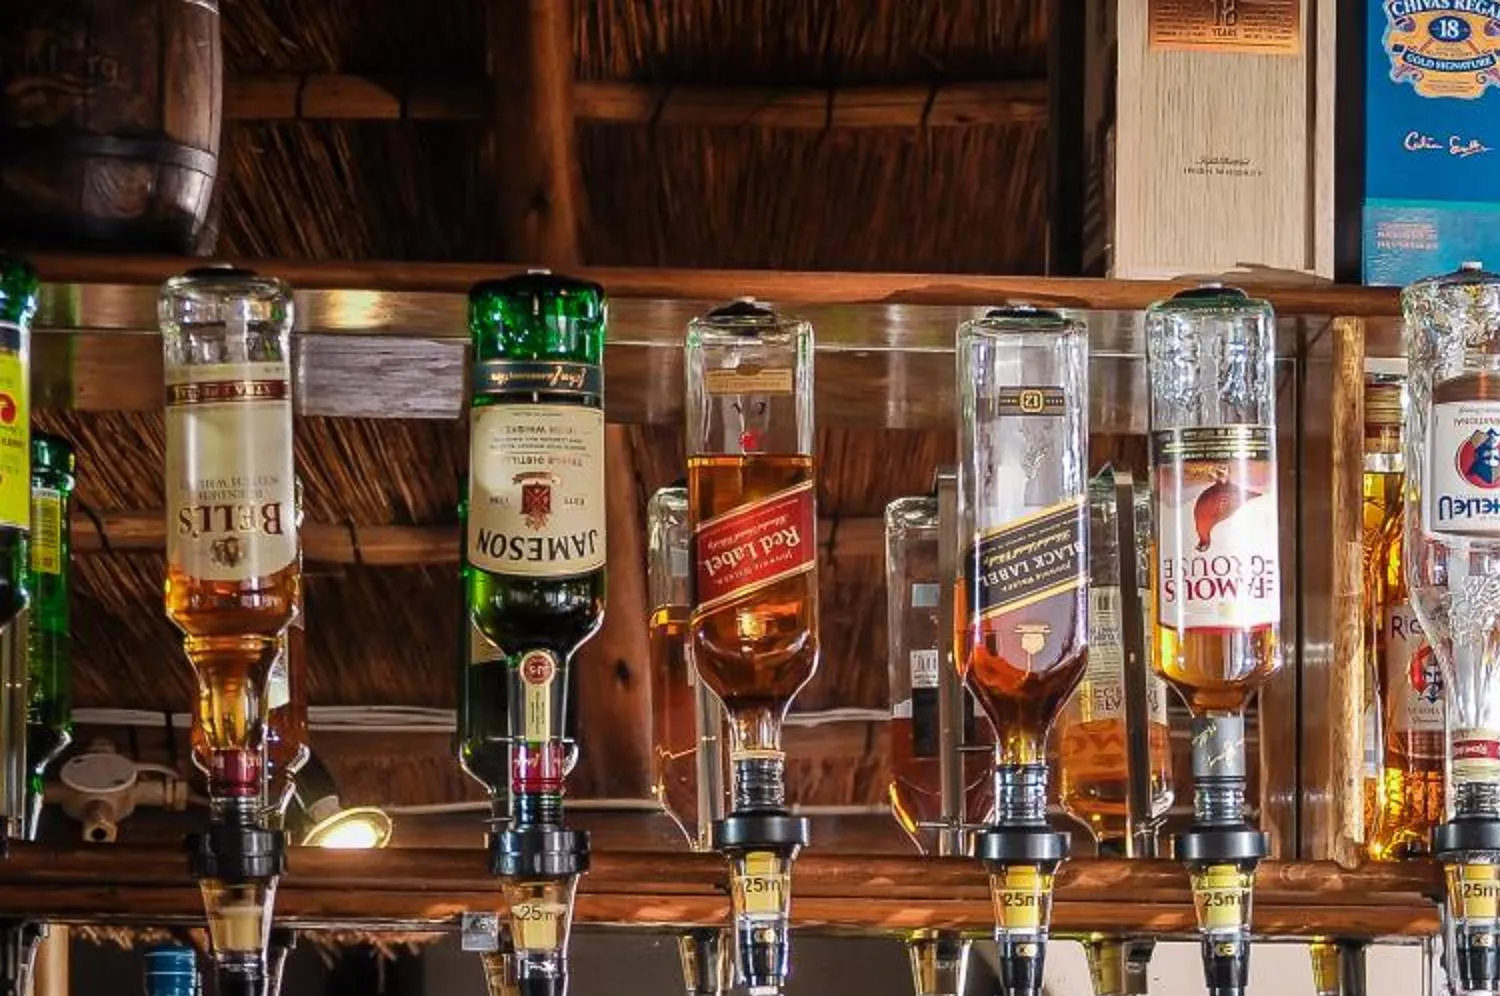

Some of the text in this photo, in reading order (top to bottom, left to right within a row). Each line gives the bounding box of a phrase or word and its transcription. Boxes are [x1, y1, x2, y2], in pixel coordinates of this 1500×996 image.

[1391, 0, 1450, 15] CHIVAS
[1439, 19, 1459, 38] 18
[1024, 394, 1039, 407] 12
[475, 527, 598, 562] JAMESON
[704, 525, 800, 576] Red Label
[977, 560, 1029, 587] LABEL
